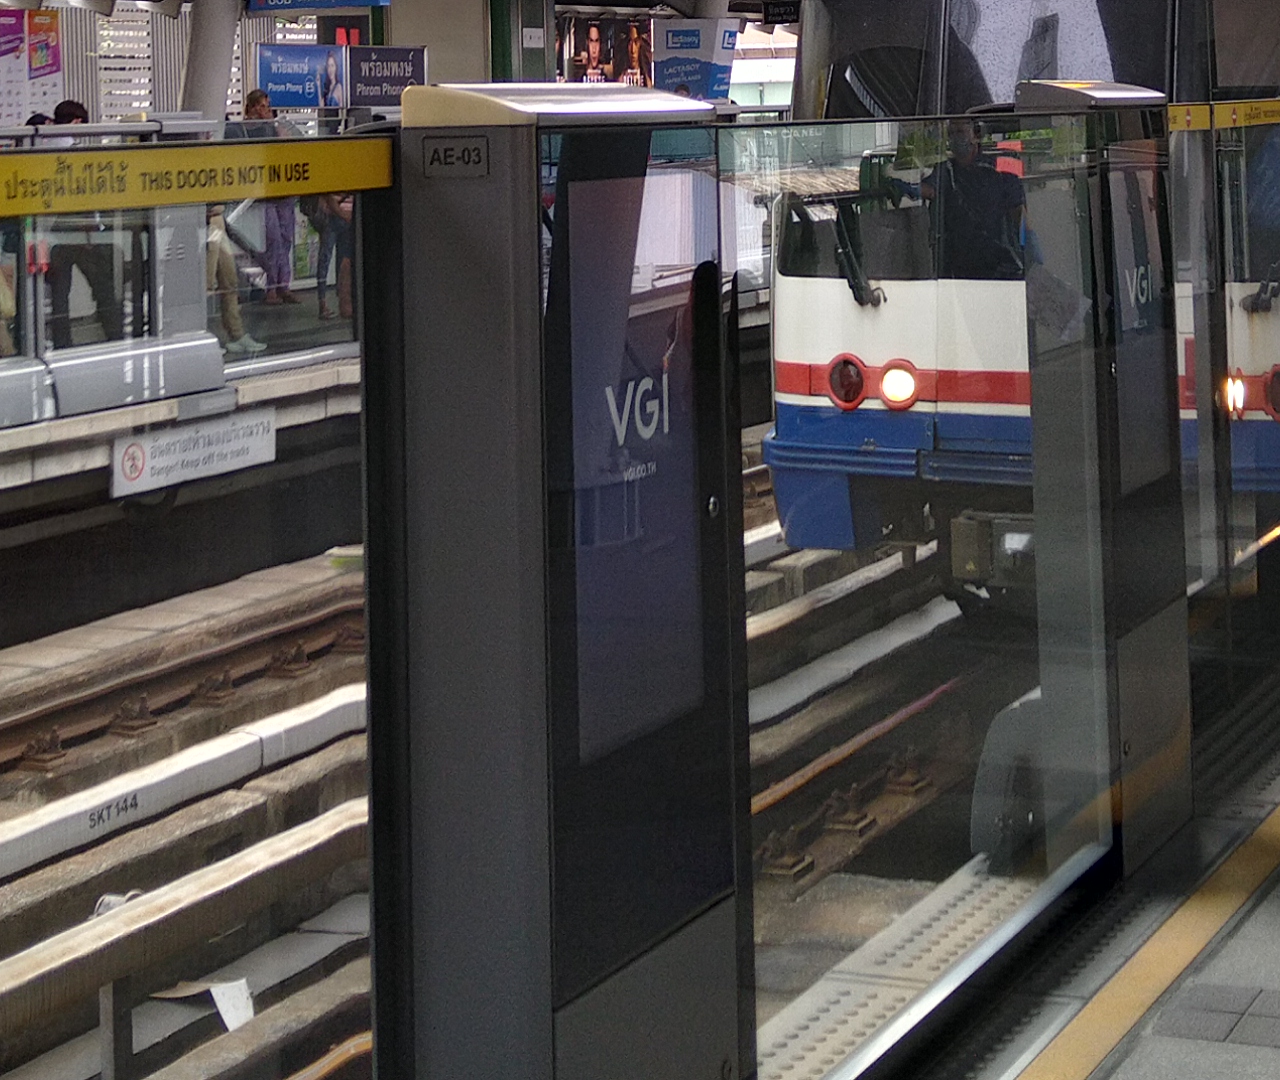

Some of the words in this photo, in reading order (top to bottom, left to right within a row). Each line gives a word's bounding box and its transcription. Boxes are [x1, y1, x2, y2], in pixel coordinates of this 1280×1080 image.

[271, 56, 309, 73] พร้อมพงษ์
[360, 51, 414, 77] พร้อมพงษ์
[268, 82, 286, 92] Phrom
[356, 83, 381, 95] Phrom
[430, 147, 481, 166] AE-03
[4, 156, 129, 209] ประตูนี้ไม่ได้ใช้
[141, 171, 173, 192] THIS
[177, 168, 219, 190] DOOR
[221, 167, 234, 186] IS
[237, 164, 266, 185] NOT
[269, 164, 282, 183] IN
[285, 162, 310, 182] USE
[1125, 264, 1152, 308] VGI
[605, 373, 669, 447] VGI
